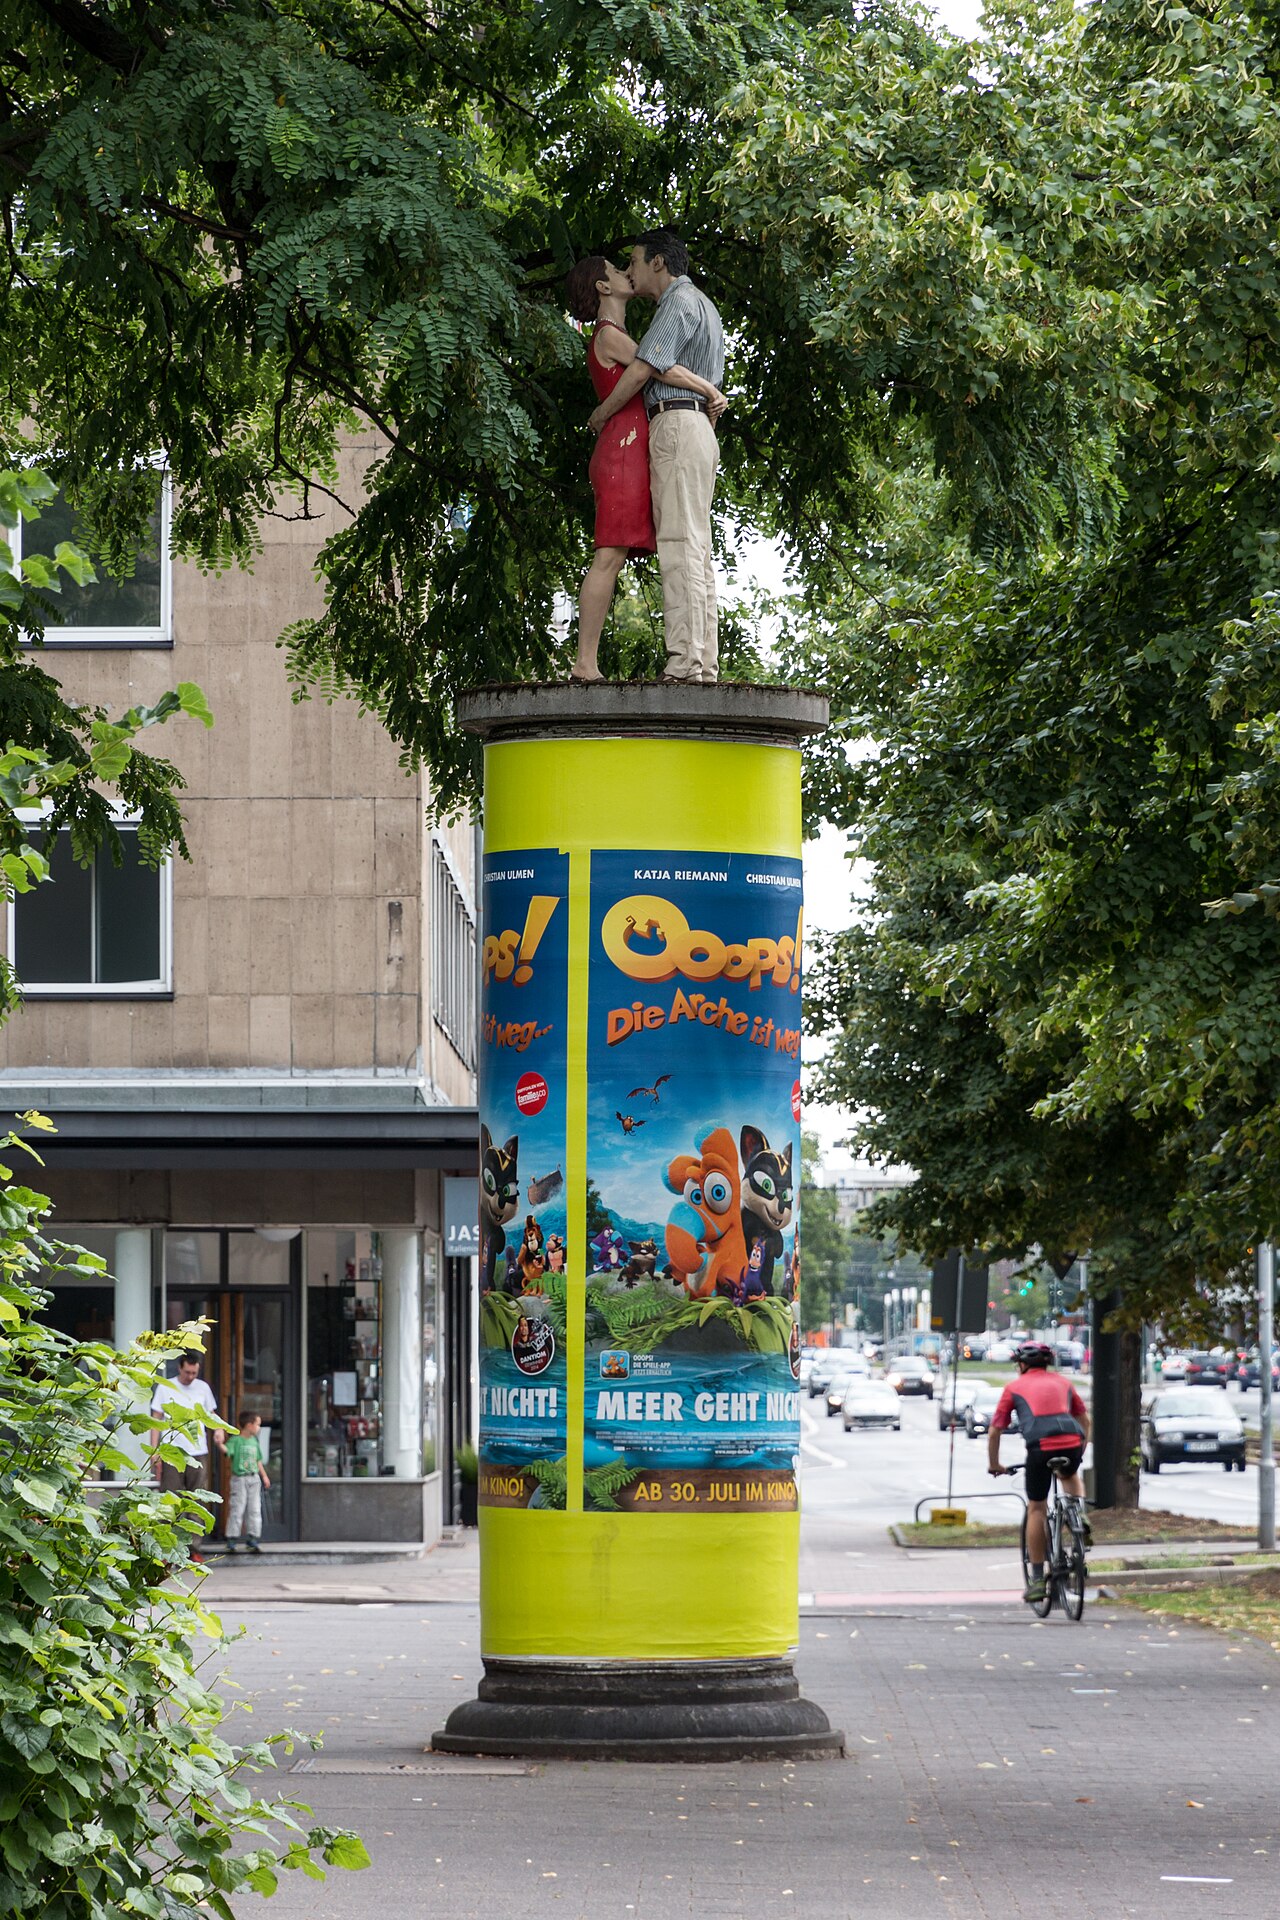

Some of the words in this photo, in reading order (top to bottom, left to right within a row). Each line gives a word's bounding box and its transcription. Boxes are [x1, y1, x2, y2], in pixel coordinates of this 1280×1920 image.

[507, 869, 534, 880] ULMEN
[634, 869, 671, 880] KATJA
[675, 871, 728, 882] RIEMANN
[746, 873, 786, 886] CHRISTIAN
[786, 877, 802, 889] ULMEN
[606, 1001, 666, 1047] Die
[668, 987, 749, 1036] Arche
[749, 1016, 775, 1048] ist
[491, 1387, 557, 1418] NICHT!
[596, 1391, 684, 1421] MEER
[694, 1392, 760, 1422] GEHT
[490, 1477, 524, 1498] KINO!
[633, 1482, 663, 1501] AB
[669, 1482, 700, 1502] 30.
[706, 1483, 741, 1502] JULI
[745, 1483, 764, 1502] IM
